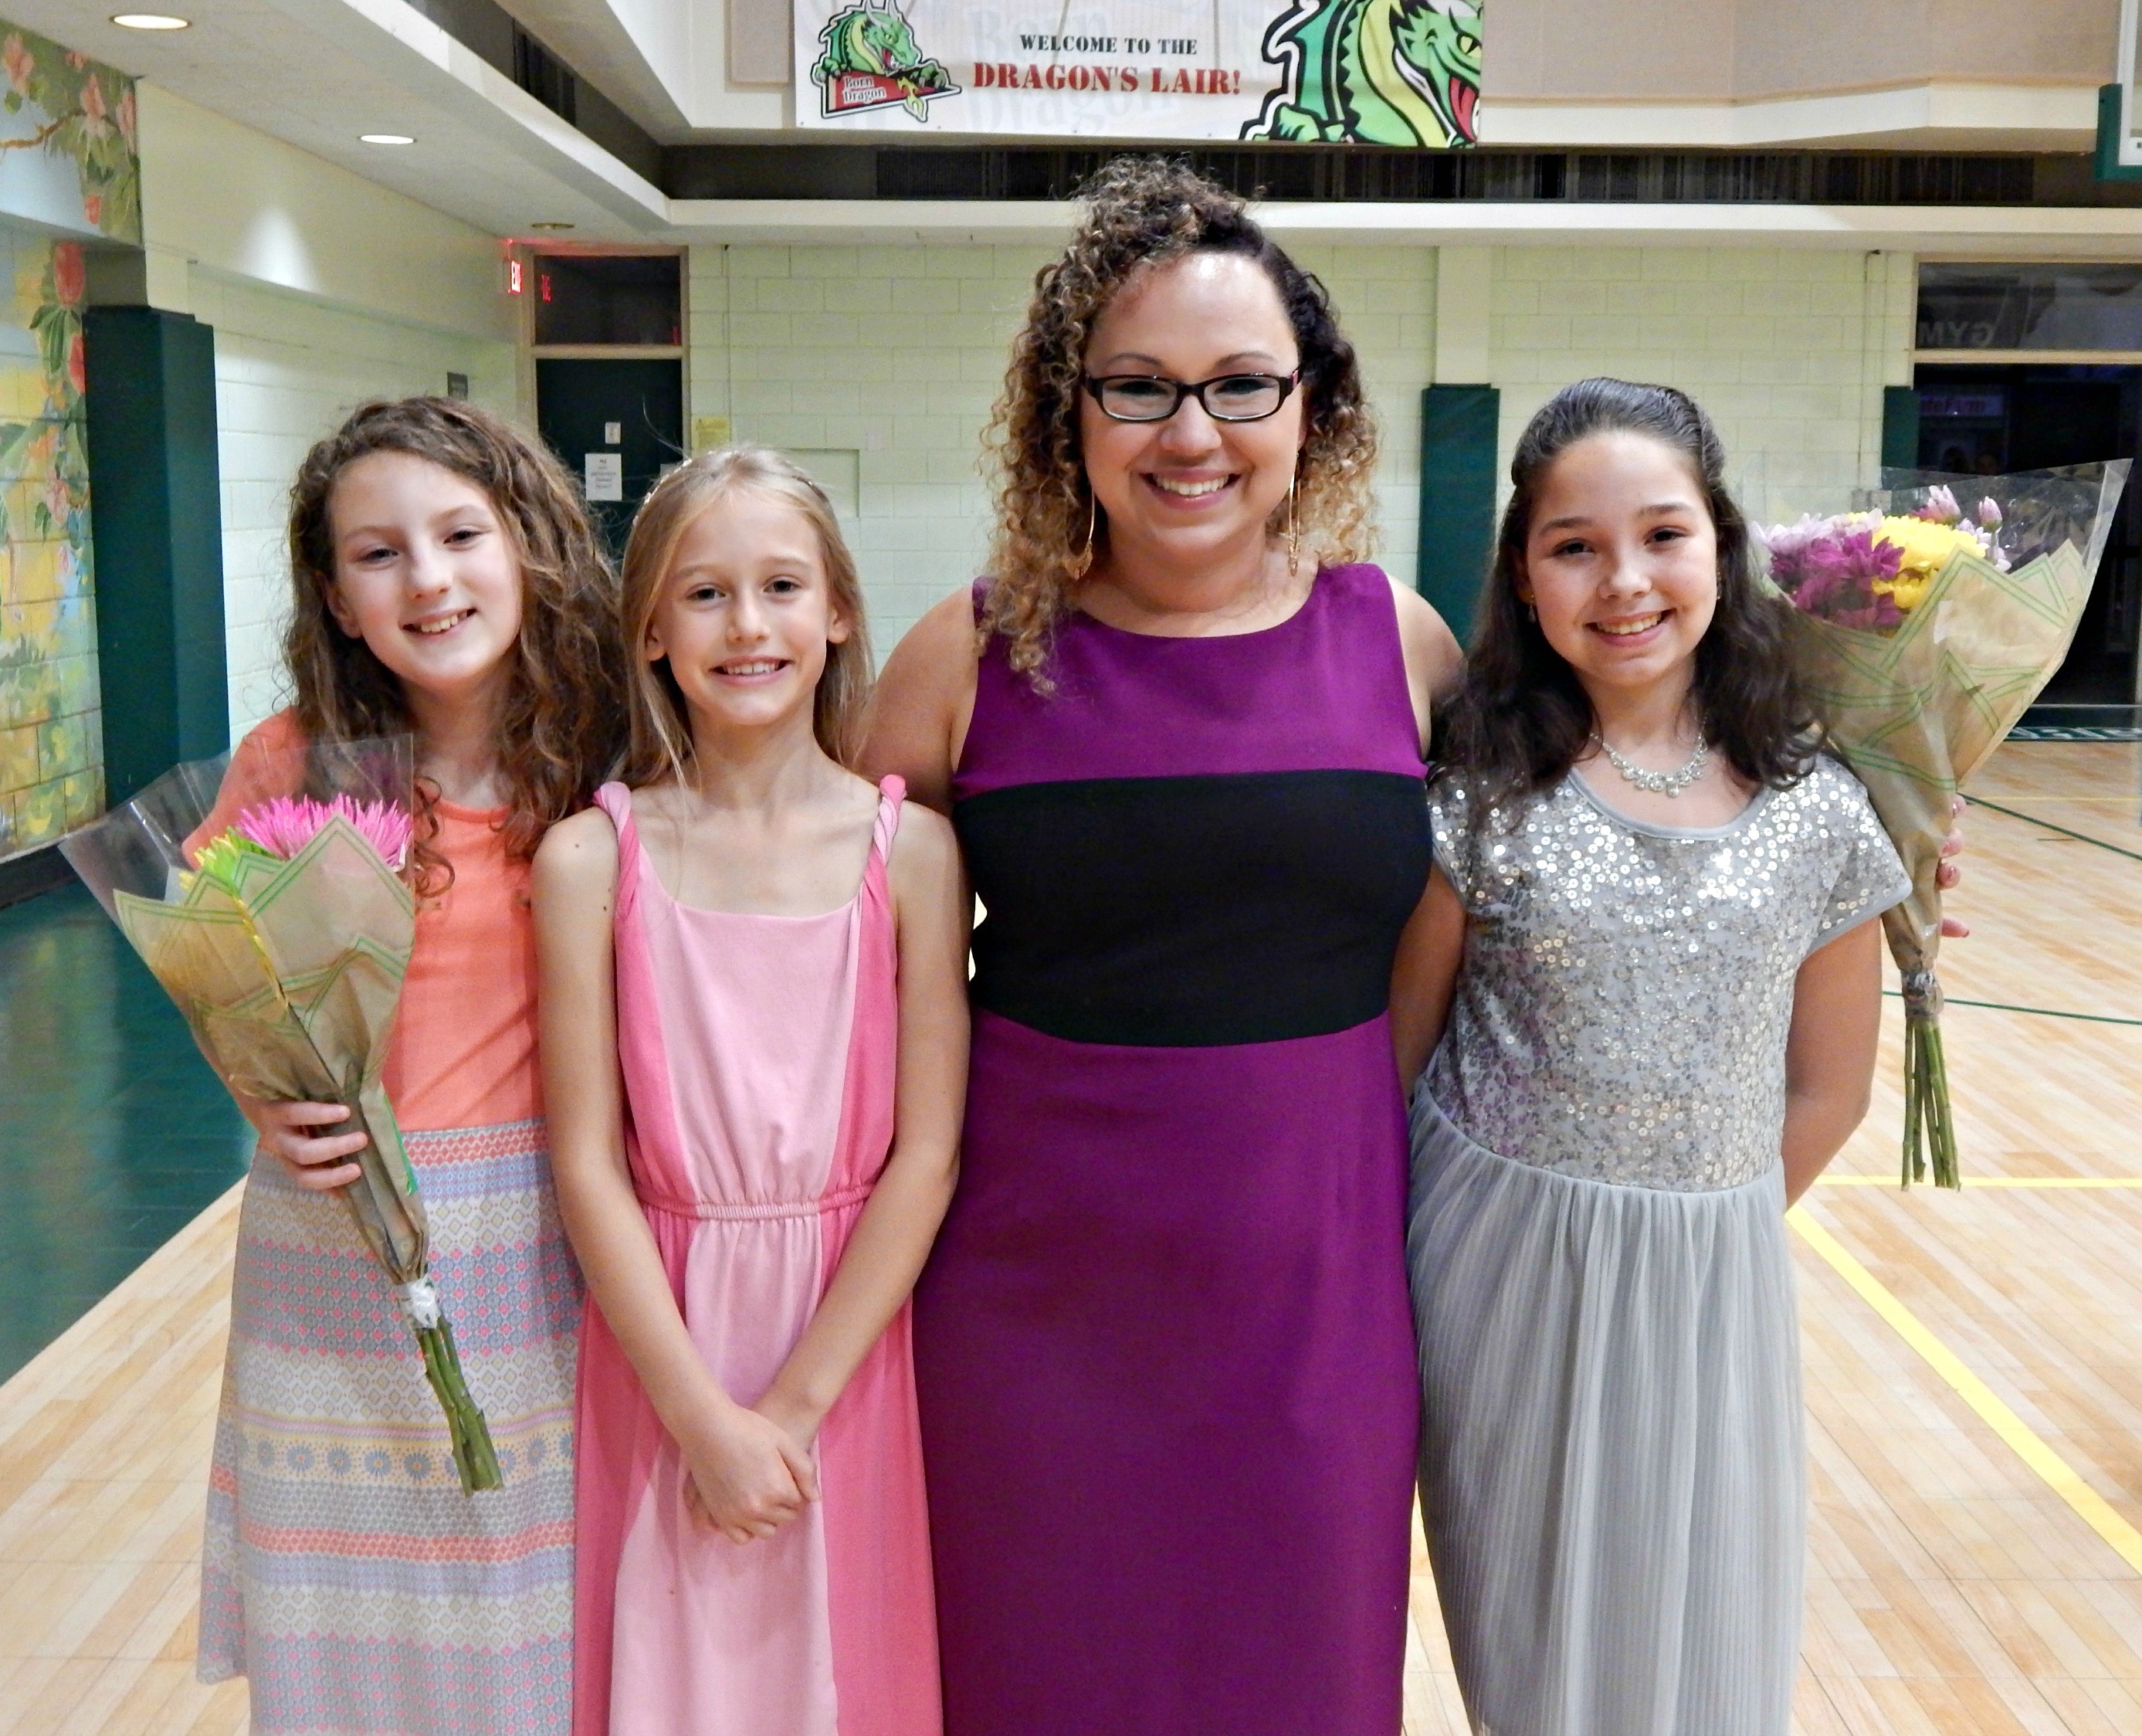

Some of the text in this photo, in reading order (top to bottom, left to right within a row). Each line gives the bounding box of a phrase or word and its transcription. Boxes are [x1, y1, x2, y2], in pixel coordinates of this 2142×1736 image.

[1020, 34, 1198, 54] WELCOME TO THE
[845, 76, 873, 88] Born
[974, 62, 1241, 95] DRAGON'S LAIR!
[845, 88, 886, 103] Dragon
